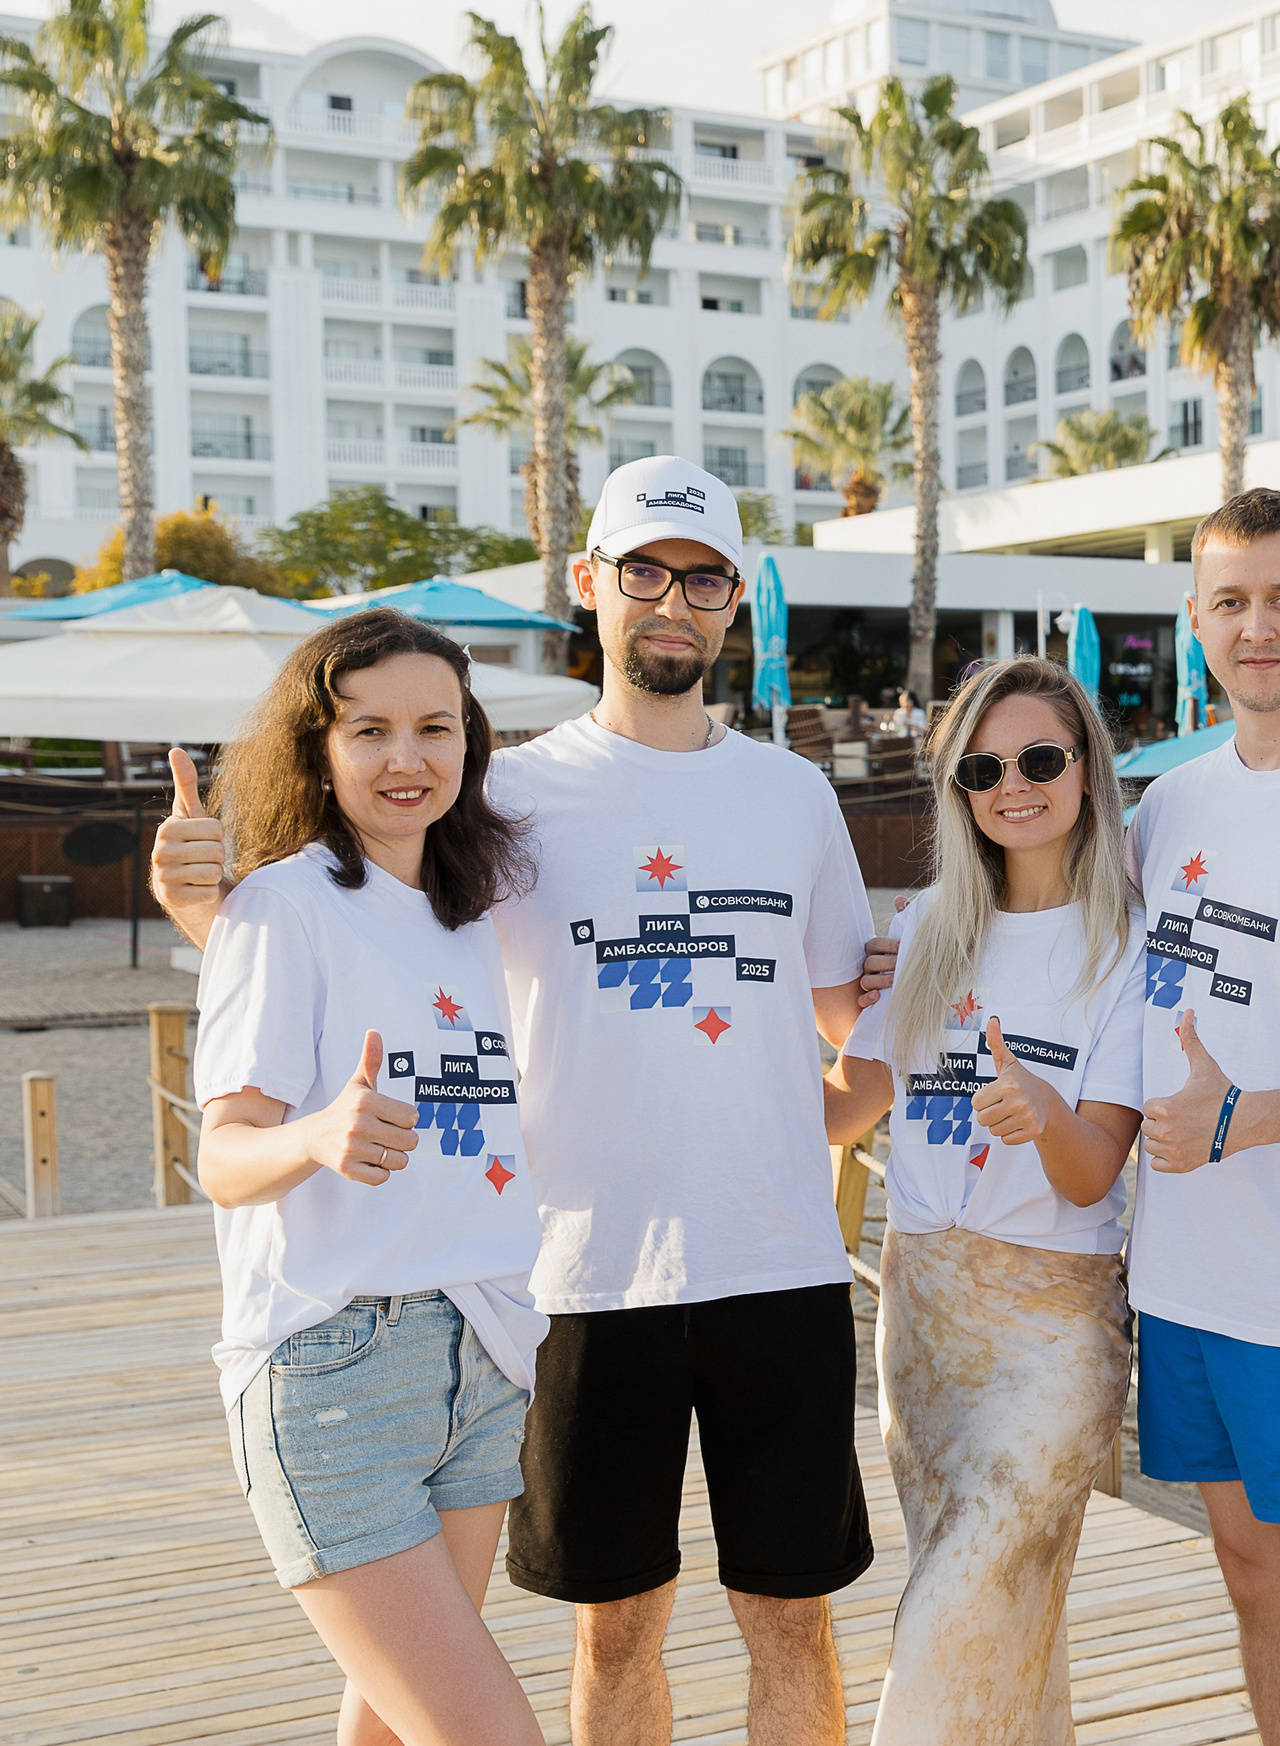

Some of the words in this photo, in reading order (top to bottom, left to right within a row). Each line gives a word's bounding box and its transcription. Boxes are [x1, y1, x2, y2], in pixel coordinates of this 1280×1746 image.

[688, 488, 704, 499] 2025
[648, 500, 702, 511] АМБАССАДОРОВ
[710, 896, 787, 910] СОВКОМБАНК
[645, 920, 685, 932] ЛИГА
[1162, 919, 1189, 934] ЛИГА
[1212, 908, 1270, 933] СОВКОМБАНК
[602, 941, 729, 958] АМБАССАДОРОВ
[741, 963, 770, 977] 2025
[1215, 980, 1247, 998] 2025
[1004, 1040, 1071, 1062] ОВКОМБАНК
[444, 1061, 474, 1073] ЛИГА
[943, 1058, 974, 1070] ЛИГА
[418, 1084, 510, 1099] АМБАССАДОРОВ
